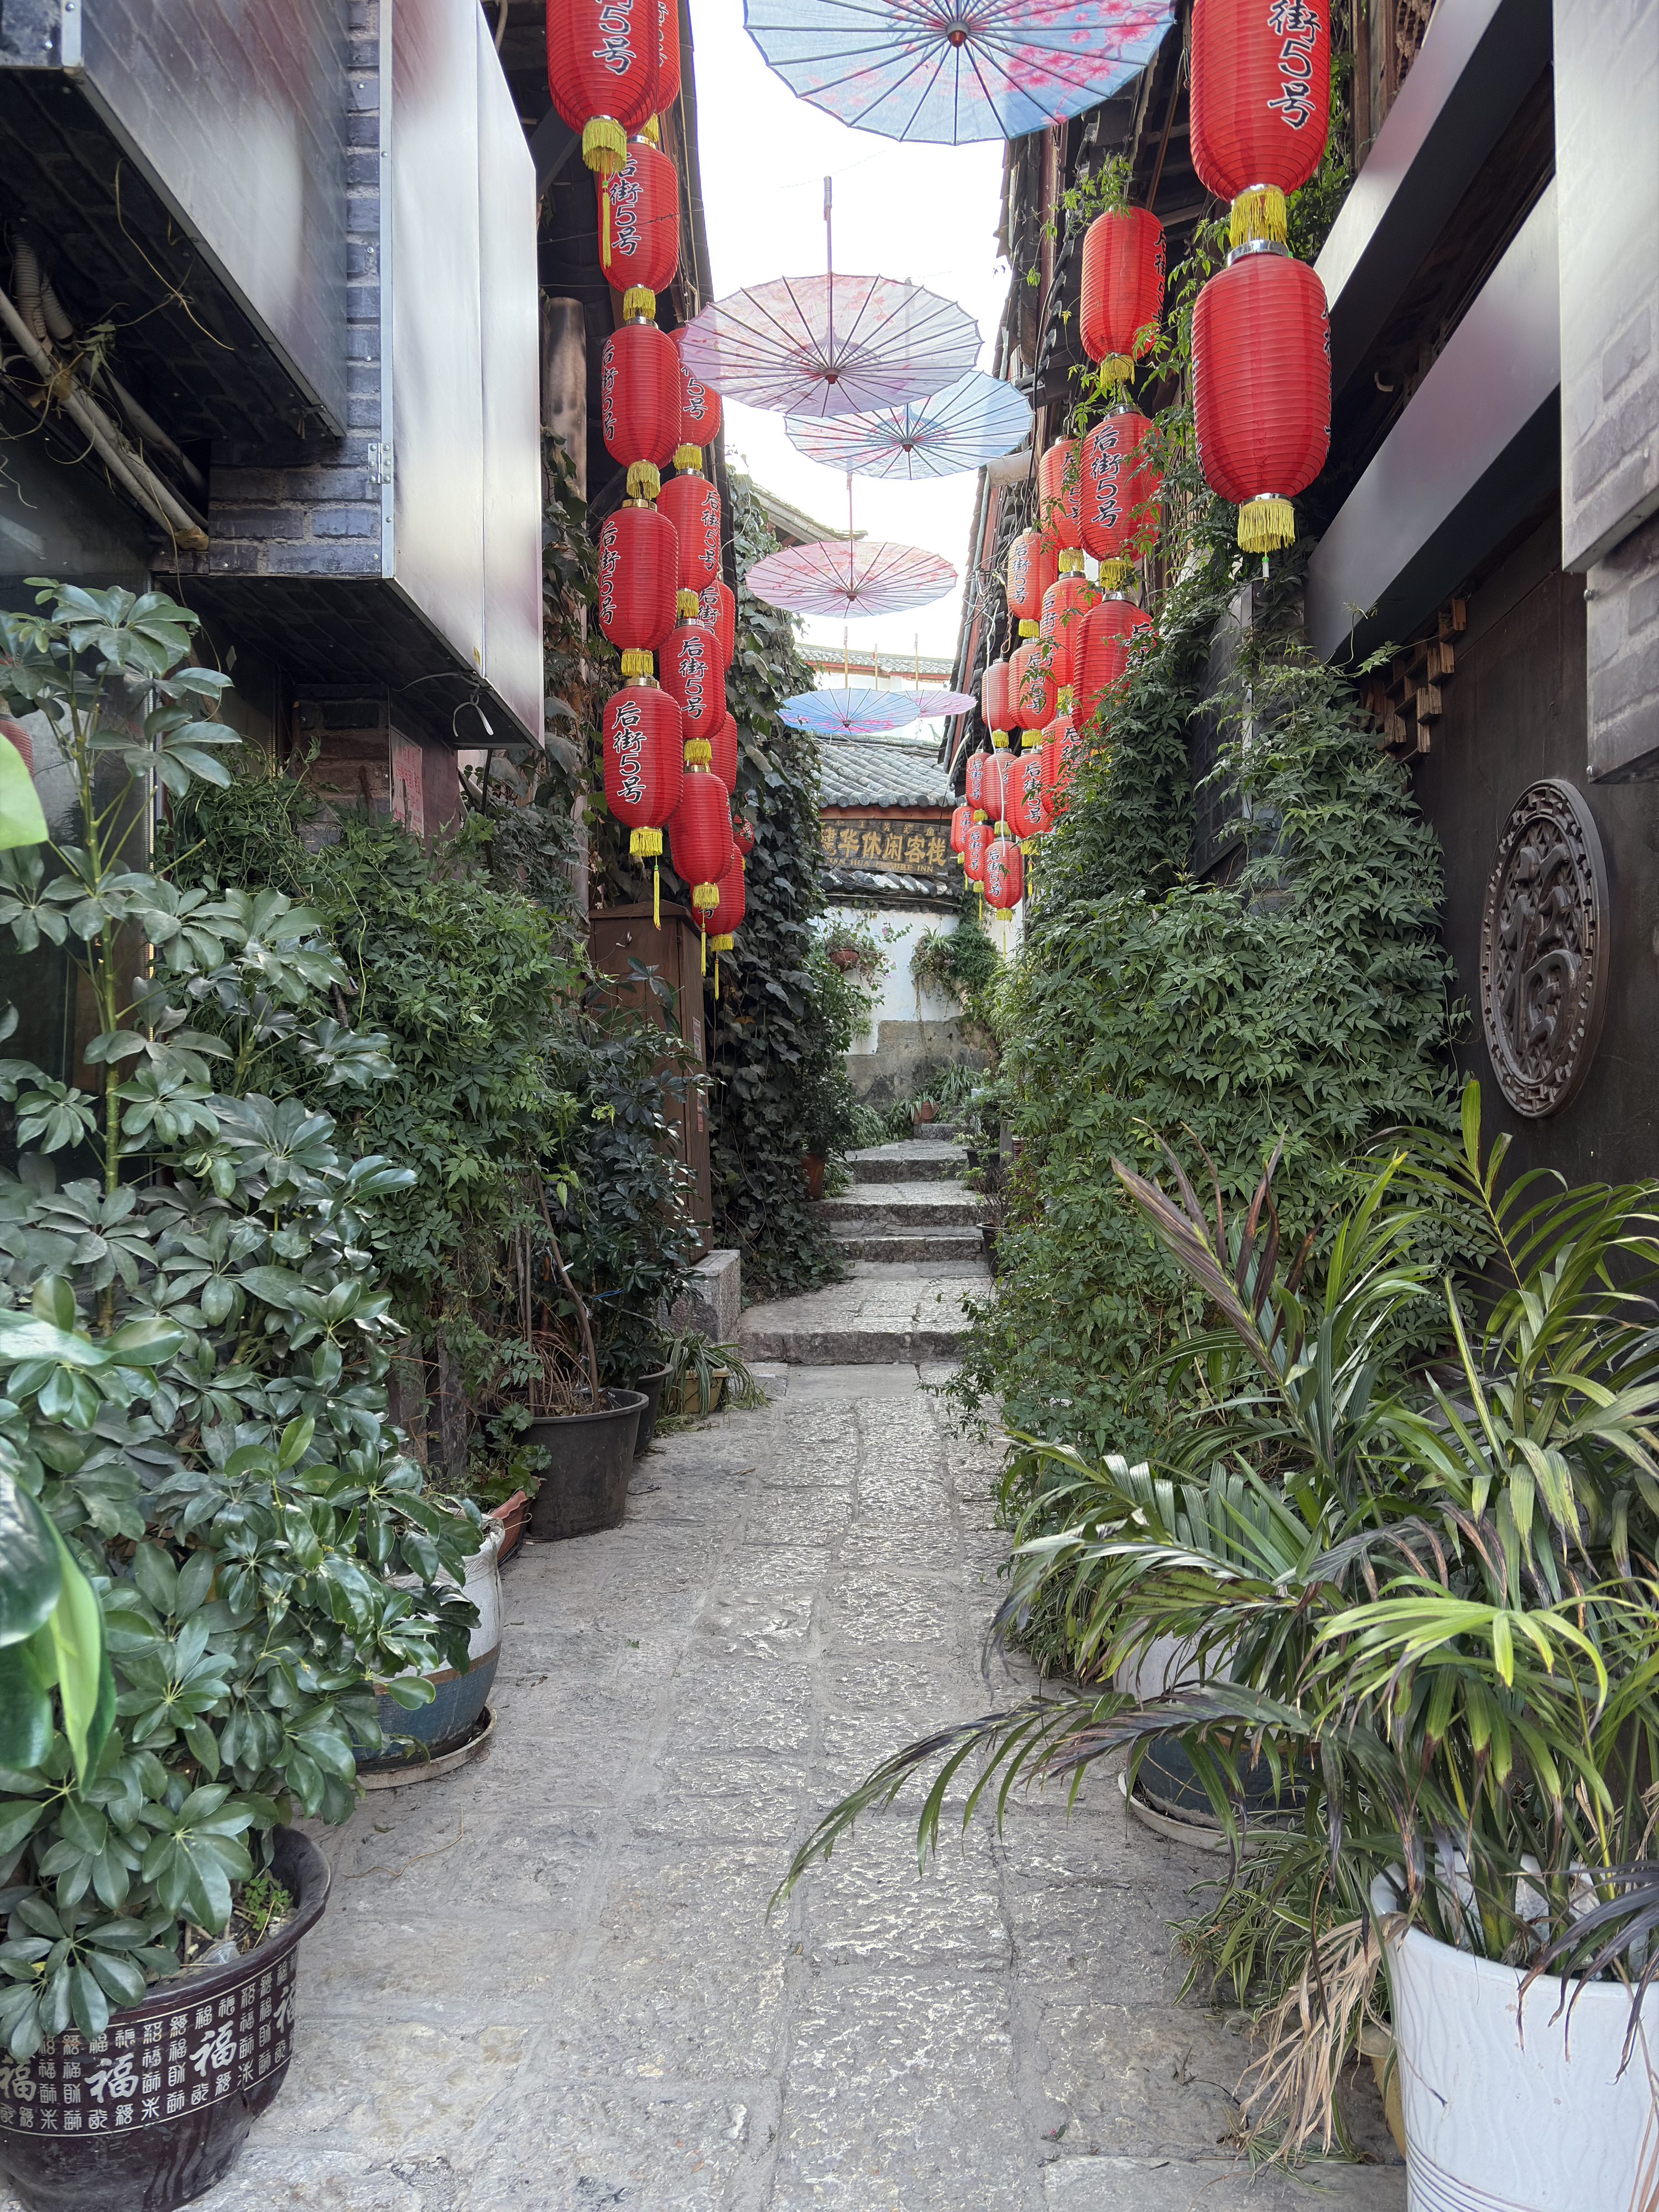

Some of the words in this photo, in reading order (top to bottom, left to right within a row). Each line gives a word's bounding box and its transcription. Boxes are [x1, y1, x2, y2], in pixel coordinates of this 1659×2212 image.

[593, 0, 637, 75] 5号
[608, 153, 644, 256] 后街5号
[681, 366, 708, 420] 5号
[1089, 424, 1123, 528] 后街5号
[698, 489, 719, 571] 后街5号
[599, 521, 621, 625] 后街5号
[1012, 541, 1031, 604] 后街5号
[678, 636, 708, 719] 后街5号
[612, 701, 647, 804] 后街5号
[970, 759, 983, 800] 后街5号
[1021, 761, 1044, 823] 后街5号
[968, 830, 983, 871] 后街5号
[987, 848, 1003, 897] 后街5号
[85, 2052, 138, 2103] 福
[189, 2020, 237, 2077] 福
